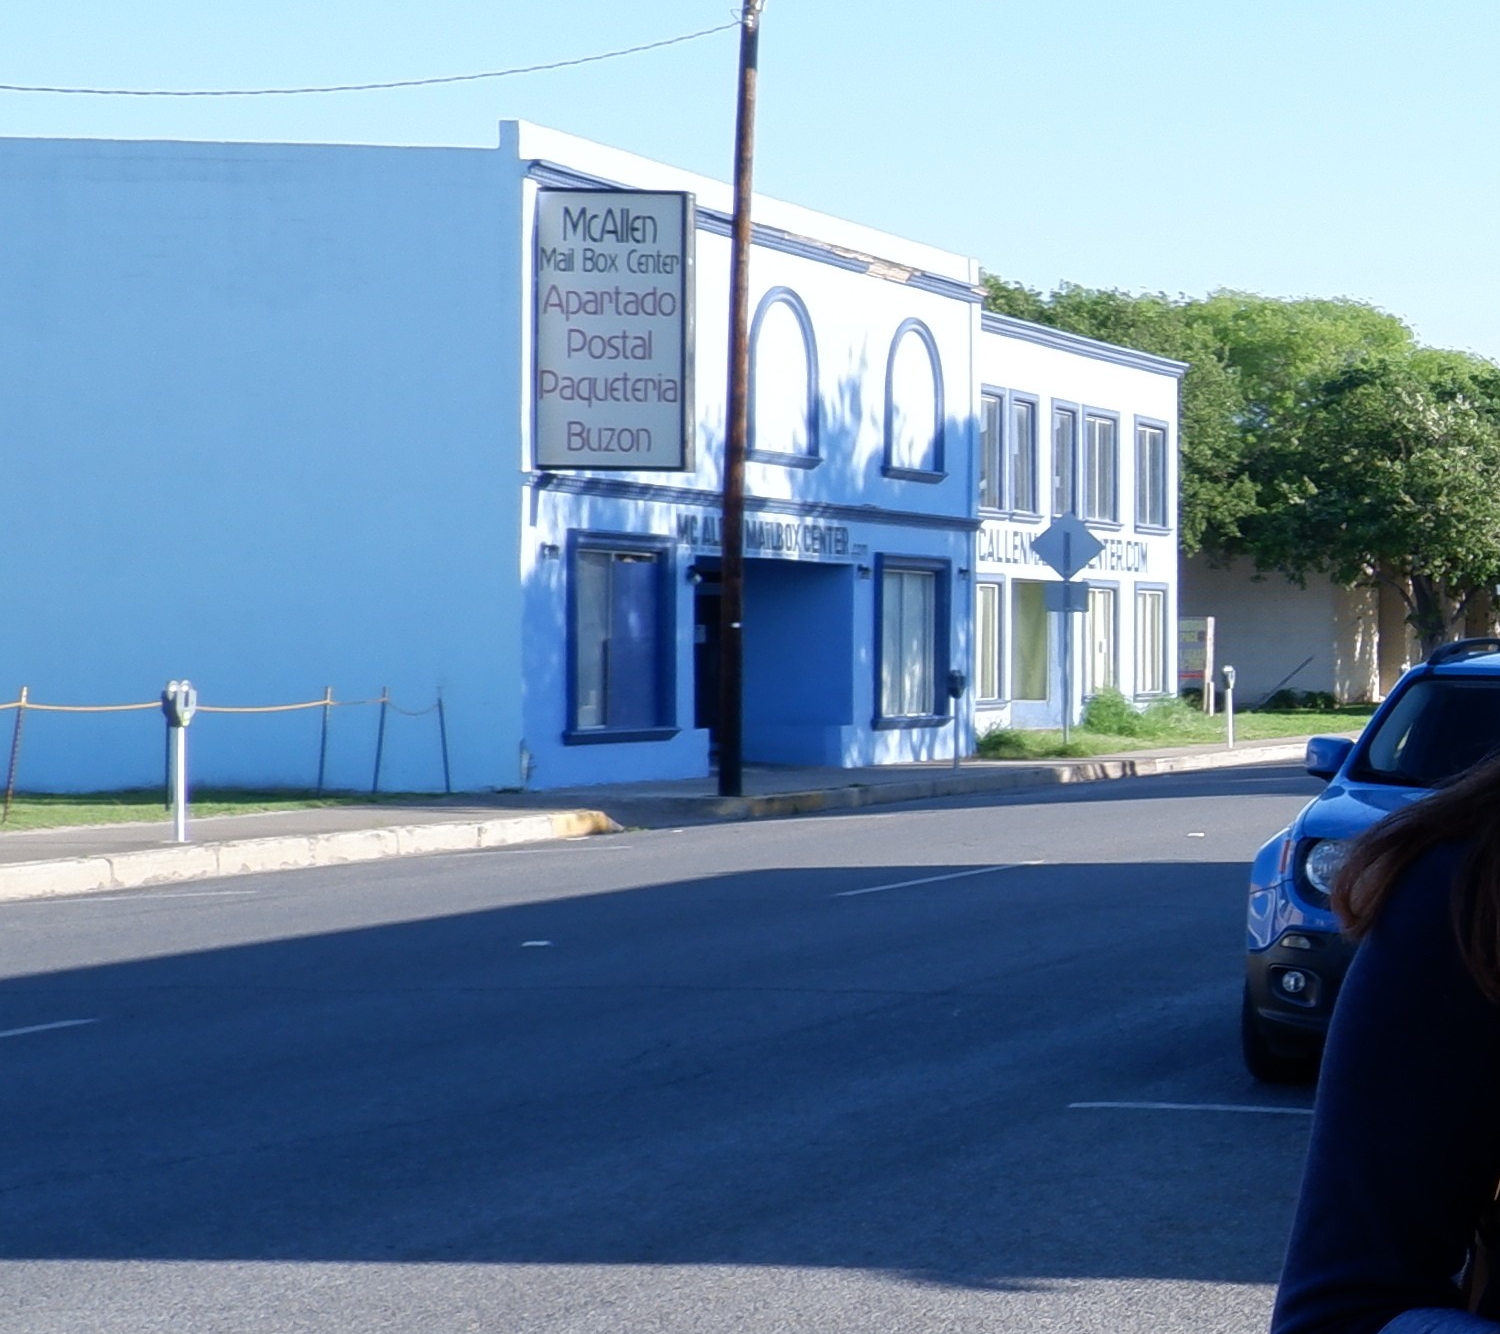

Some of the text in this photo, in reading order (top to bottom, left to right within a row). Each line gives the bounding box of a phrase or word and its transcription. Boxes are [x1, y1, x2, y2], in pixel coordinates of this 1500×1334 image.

[562, 206, 657, 244] McAllen
[540, 247, 680, 275] Mail Box Center
[543, 284, 677, 321] Apartado
[566, 328, 653, 361] Postal
[539, 370, 679, 407] Paqueteria
[566, 421, 652, 453] Buzon
[802, 524, 850, 555] CENTER
